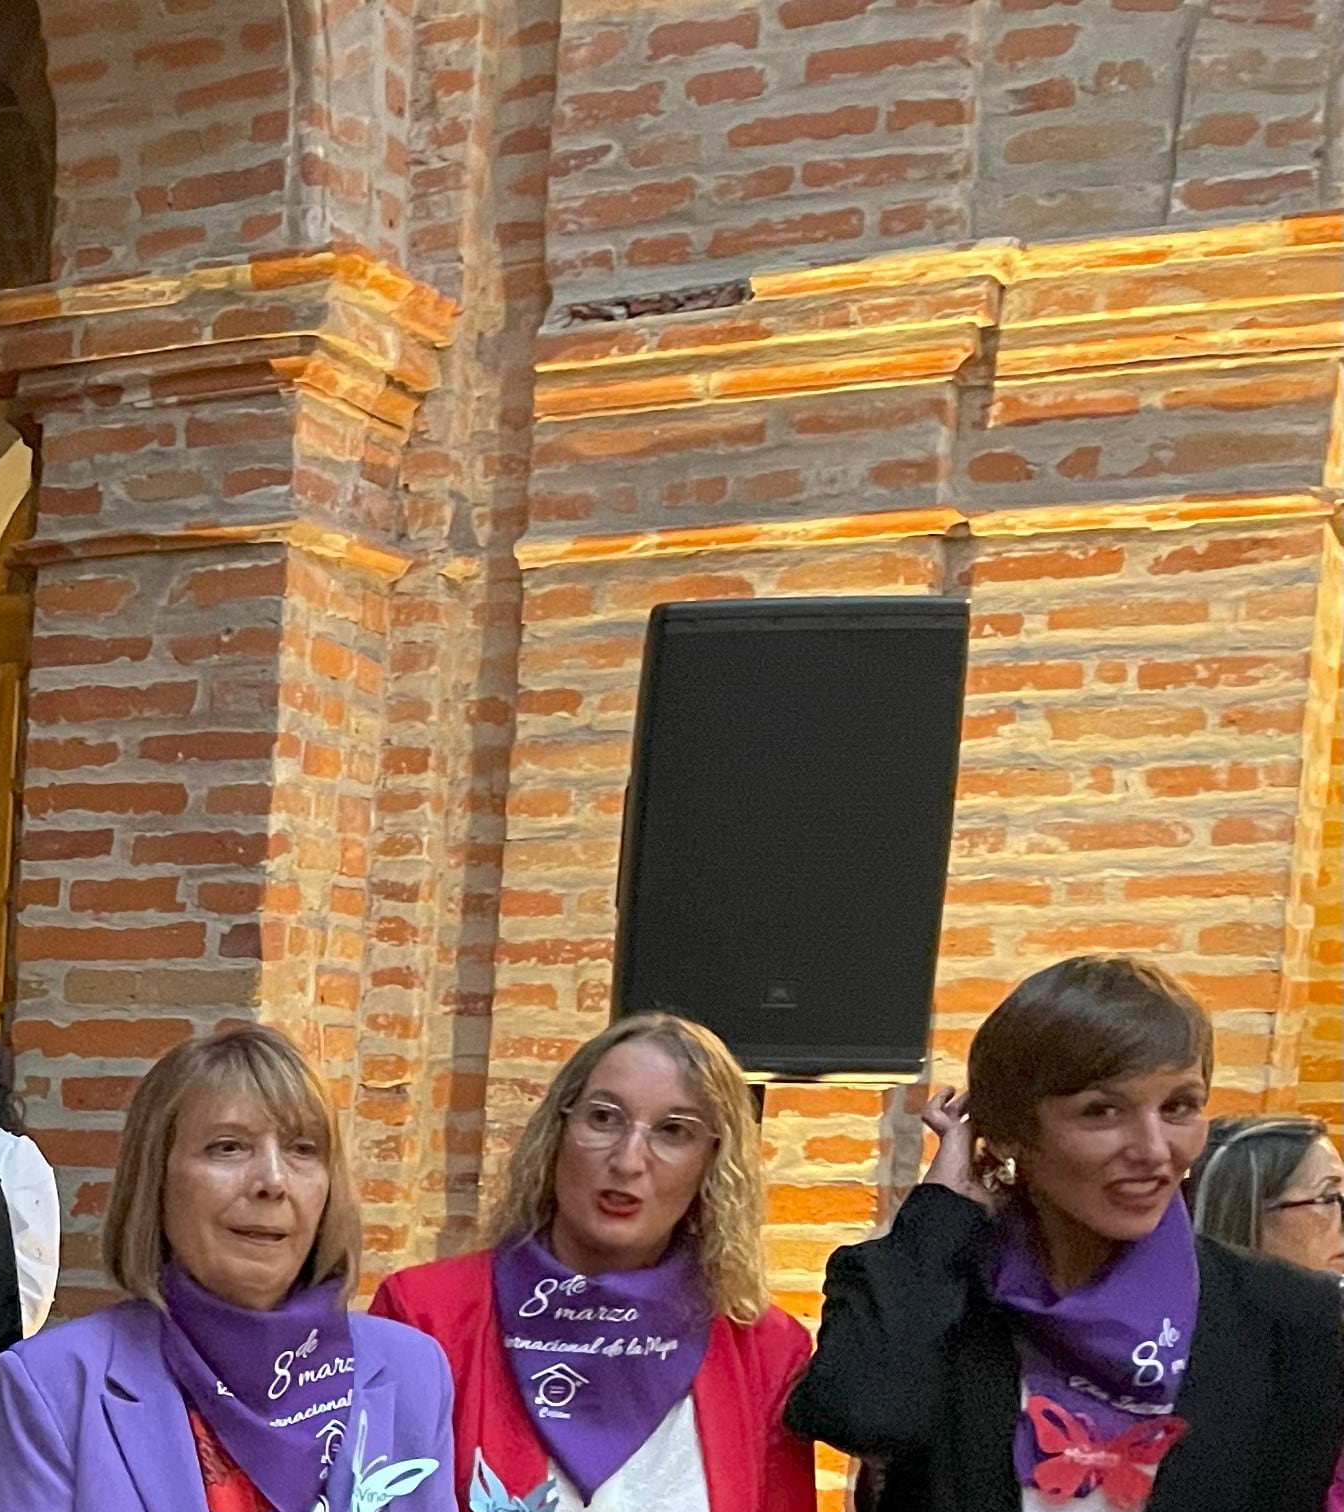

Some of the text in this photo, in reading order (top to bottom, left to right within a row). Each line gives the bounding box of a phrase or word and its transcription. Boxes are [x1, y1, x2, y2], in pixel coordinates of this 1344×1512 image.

[518, 1274, 588, 1318] 8 de
[553, 1305, 640, 1322] marzo
[298, 1357, 355, 1387] marz
[1132, 1341, 1165, 1387] 8
[1158, 1318, 1181, 1348] de
[267, 1350, 294, 1400] 8
